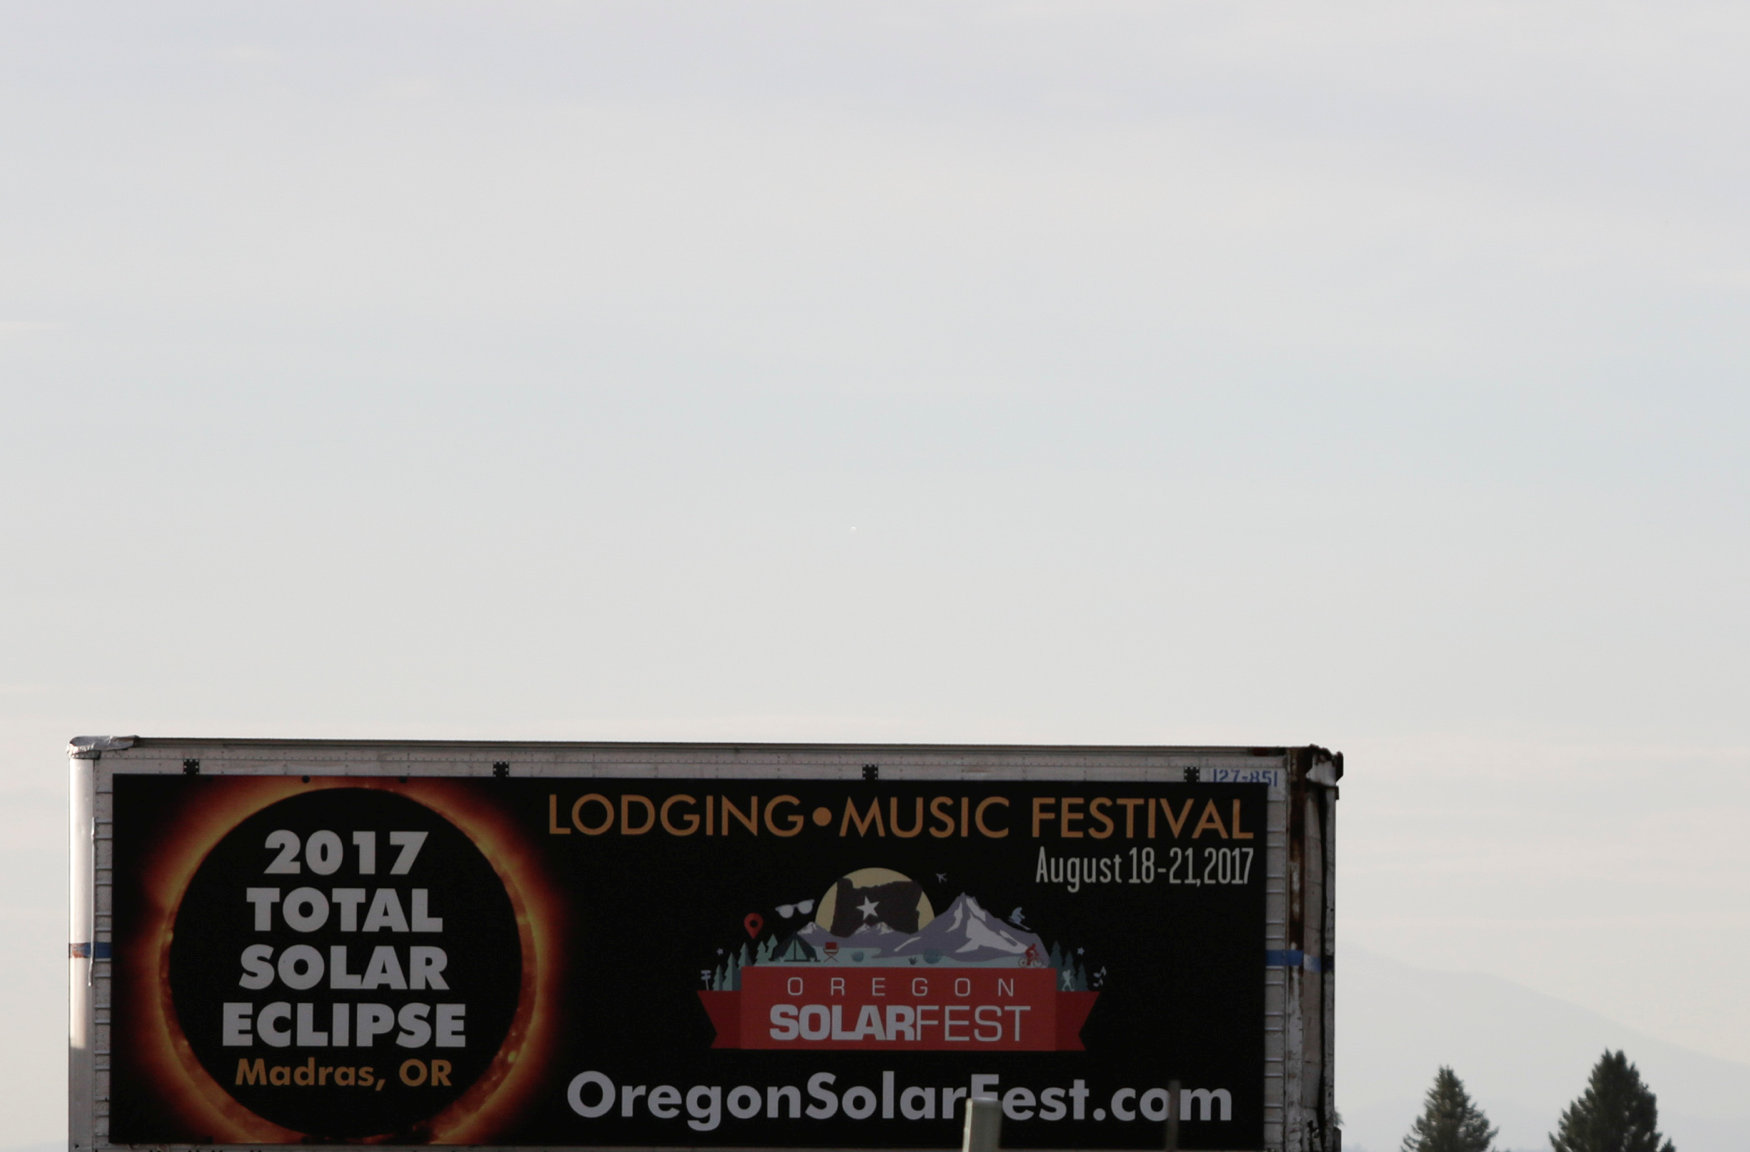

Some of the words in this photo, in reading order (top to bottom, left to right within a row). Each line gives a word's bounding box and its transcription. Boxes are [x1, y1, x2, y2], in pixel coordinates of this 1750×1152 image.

[1032, 797, 1254, 839] FESTIVAL
[263, 829, 429, 875] 2017
[1035, 846, 1122, 893] August
[246, 887, 443, 933] TOTAL
[238, 944, 450, 990] SOLAR
[786, 976, 1014, 998] OREGON
[222, 1002, 466, 1048] ECLIPSE
[769, 1004, 1032, 1042] SOLARFEST
[234, 1057, 385, 1091] Madras,
[399, 1058, 452, 1087] OR
[566, 1070, 1232, 1132] OregonSolarFest.com
